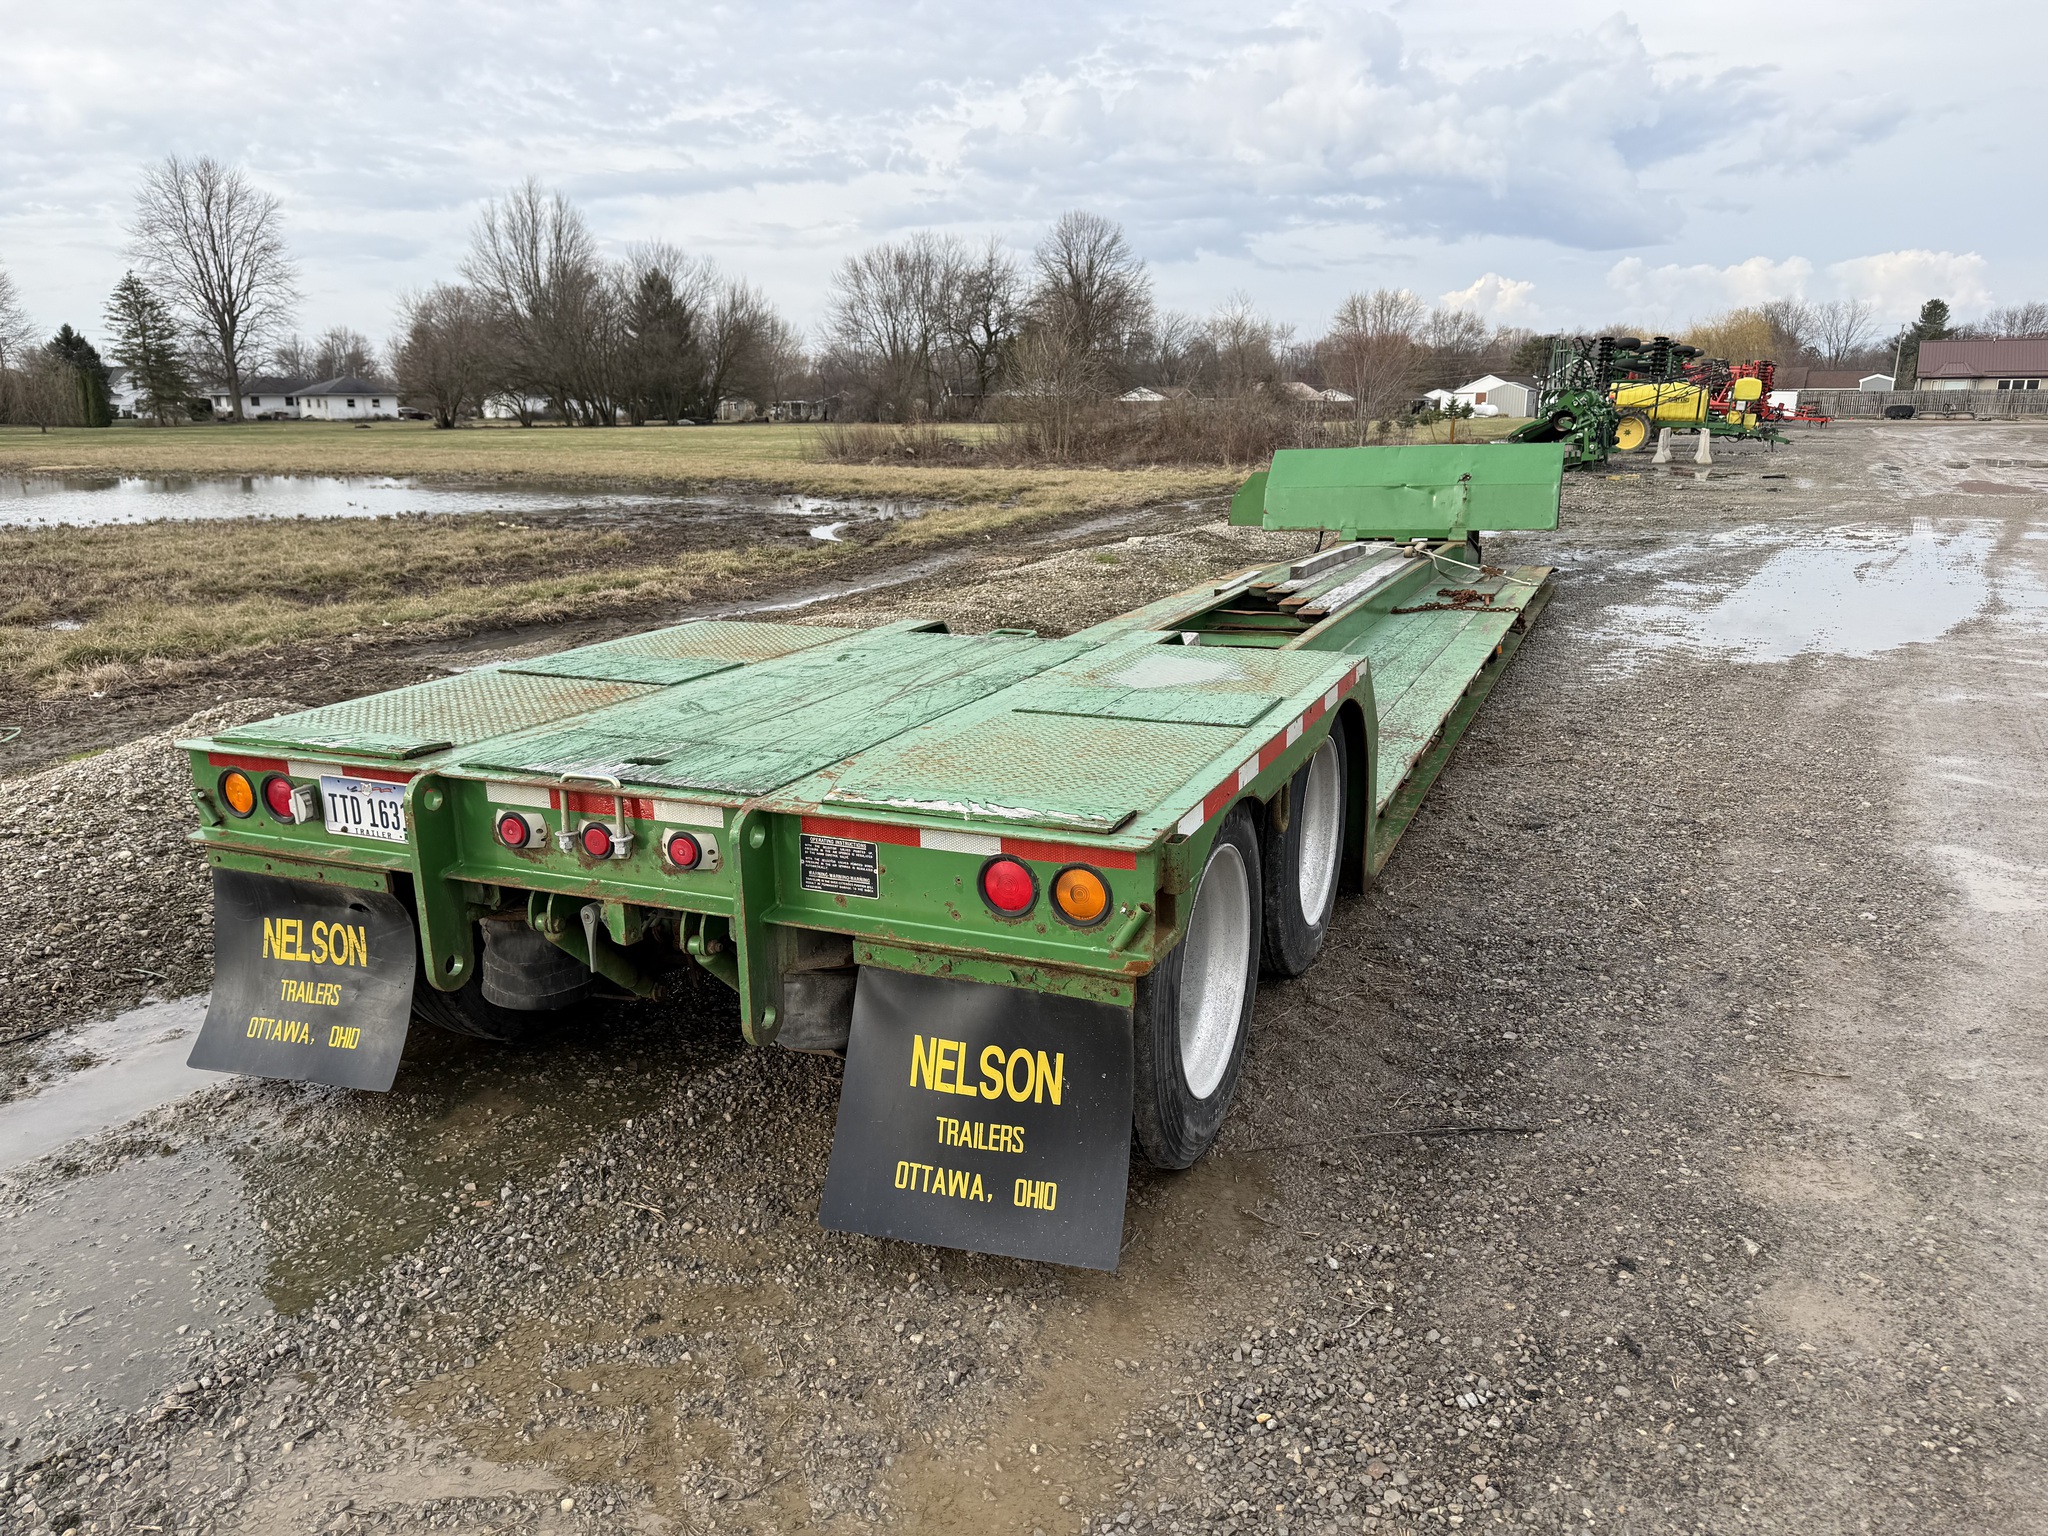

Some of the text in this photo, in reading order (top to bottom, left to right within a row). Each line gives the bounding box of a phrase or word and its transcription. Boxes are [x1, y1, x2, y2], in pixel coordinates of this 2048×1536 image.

[328, 793, 362, 825] TTD
[354, 828, 392, 839] TRAILER
[263, 918, 367, 967] NELSON
[281, 979, 342, 1007] TRAILERS
[247, 1017, 361, 1050] OTTAWA, OHIO
[909, 1035, 1065, 1106] NELSON
[936, 1116, 1025, 1154] TRAILERS
[894, 1161, 1058, 1212] OTTAWA, OHIO
